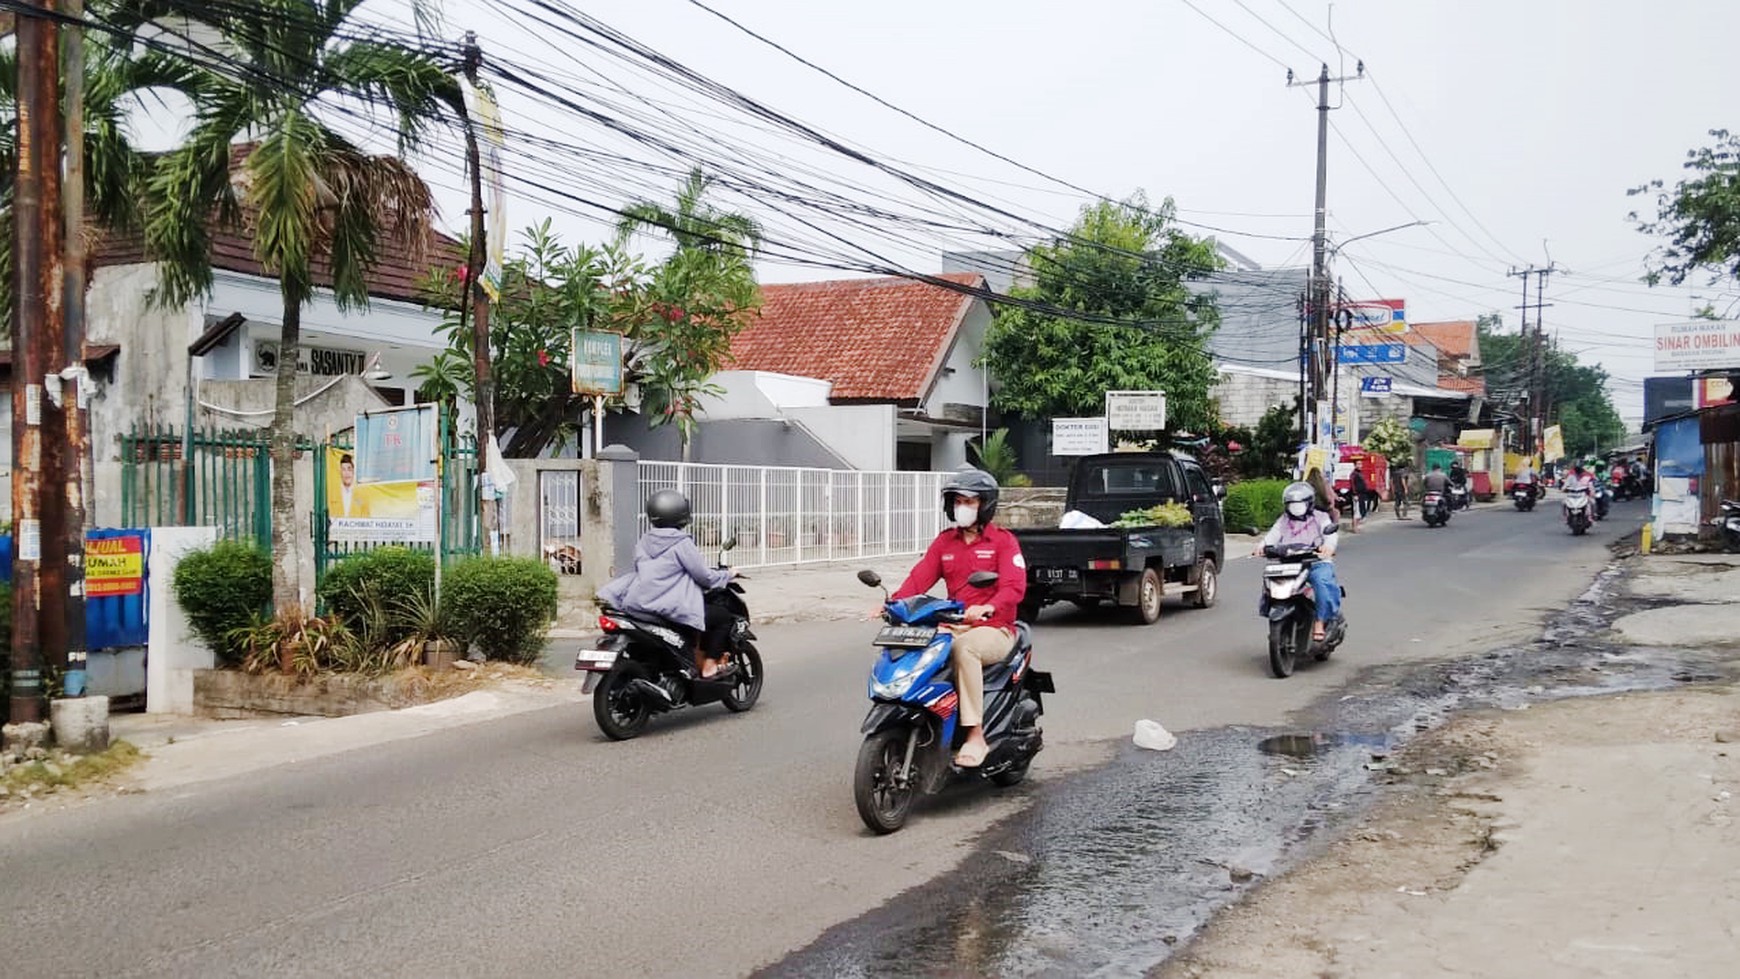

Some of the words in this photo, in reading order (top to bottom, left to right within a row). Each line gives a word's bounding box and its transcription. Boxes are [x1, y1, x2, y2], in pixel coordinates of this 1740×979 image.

[1657, 335, 1691, 351] SINAR
[1694, 331, 1740, 349] OMBILIN
[312, 348, 356, 375] SASANTY
[1055, 423, 1083, 431] DOKTER
[86, 557, 127, 568] UMAH
